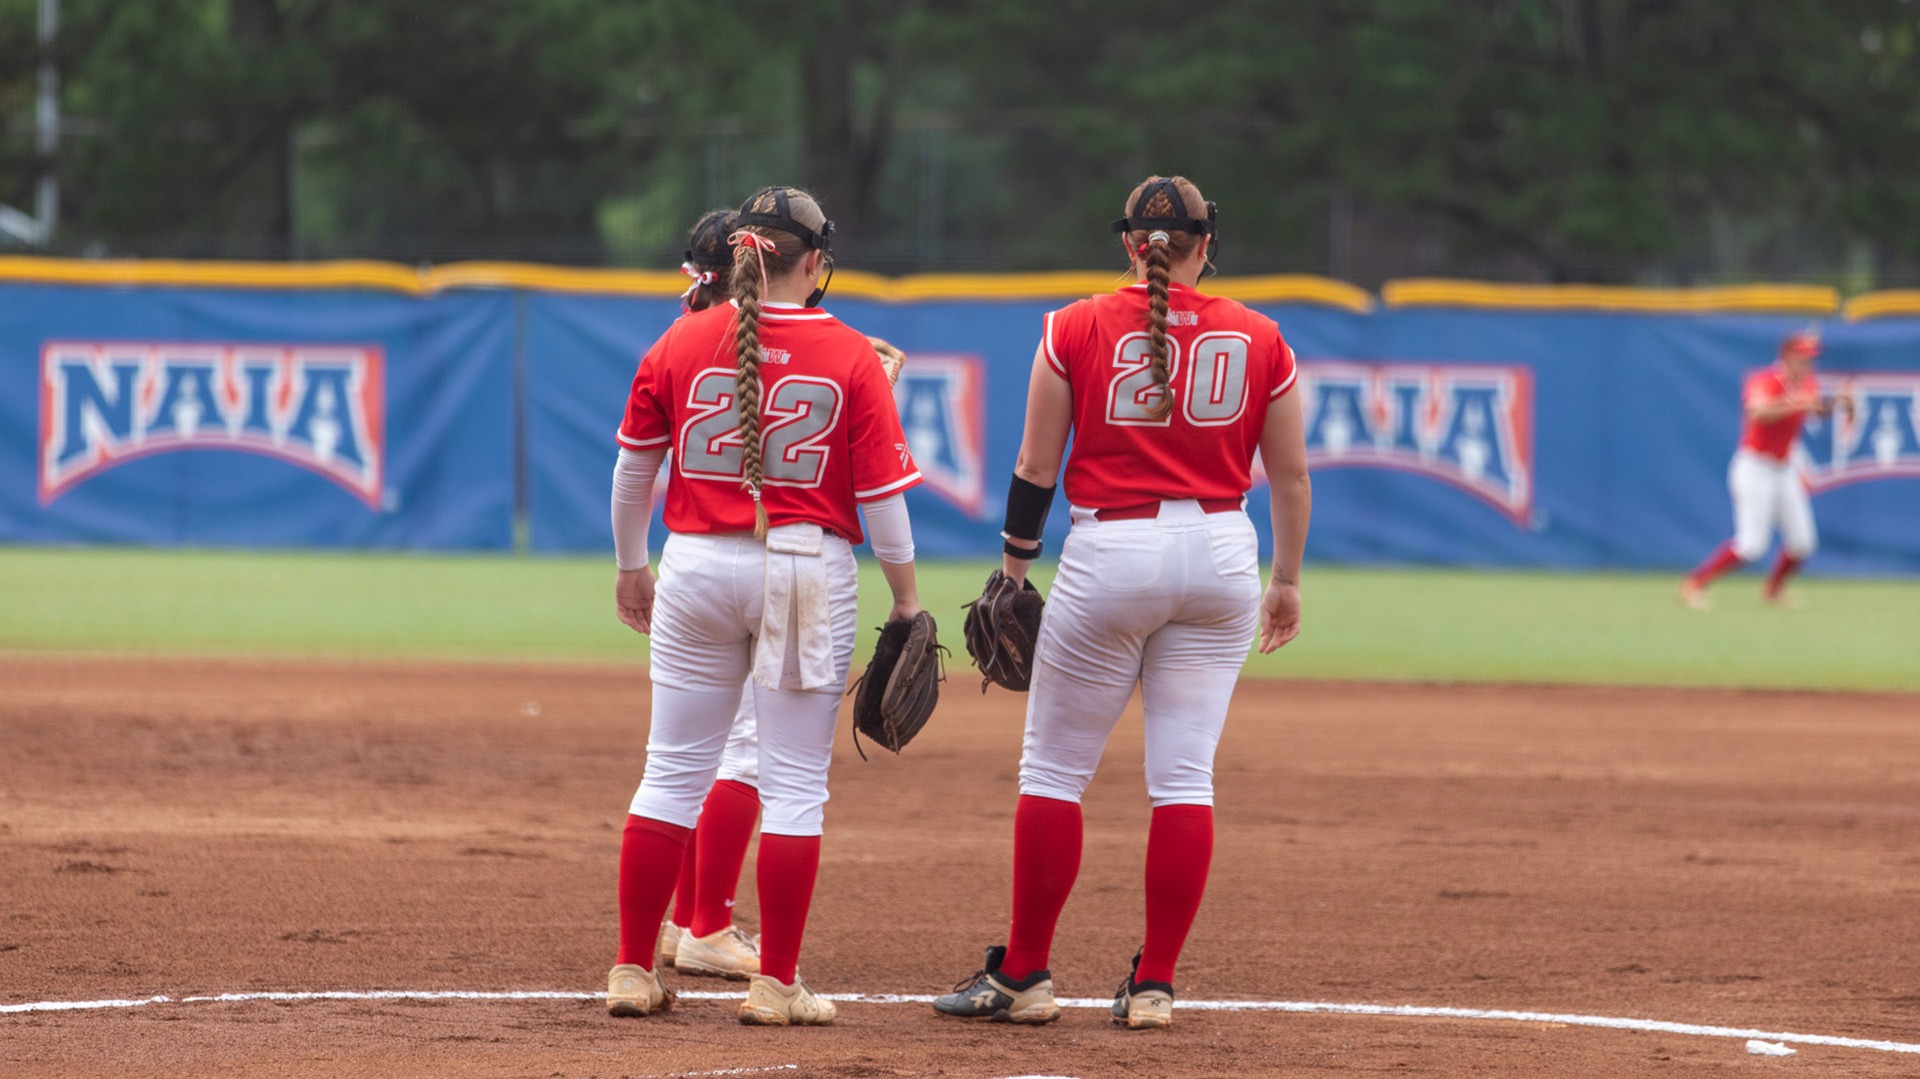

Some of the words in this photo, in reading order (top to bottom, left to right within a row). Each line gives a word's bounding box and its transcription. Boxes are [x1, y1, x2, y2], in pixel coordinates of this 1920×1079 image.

[48, 352, 374, 490] NAIA
[679, 367, 843, 488] 22
[1105, 331, 1251, 427] 20
[1298, 372, 1522, 500] AIA
